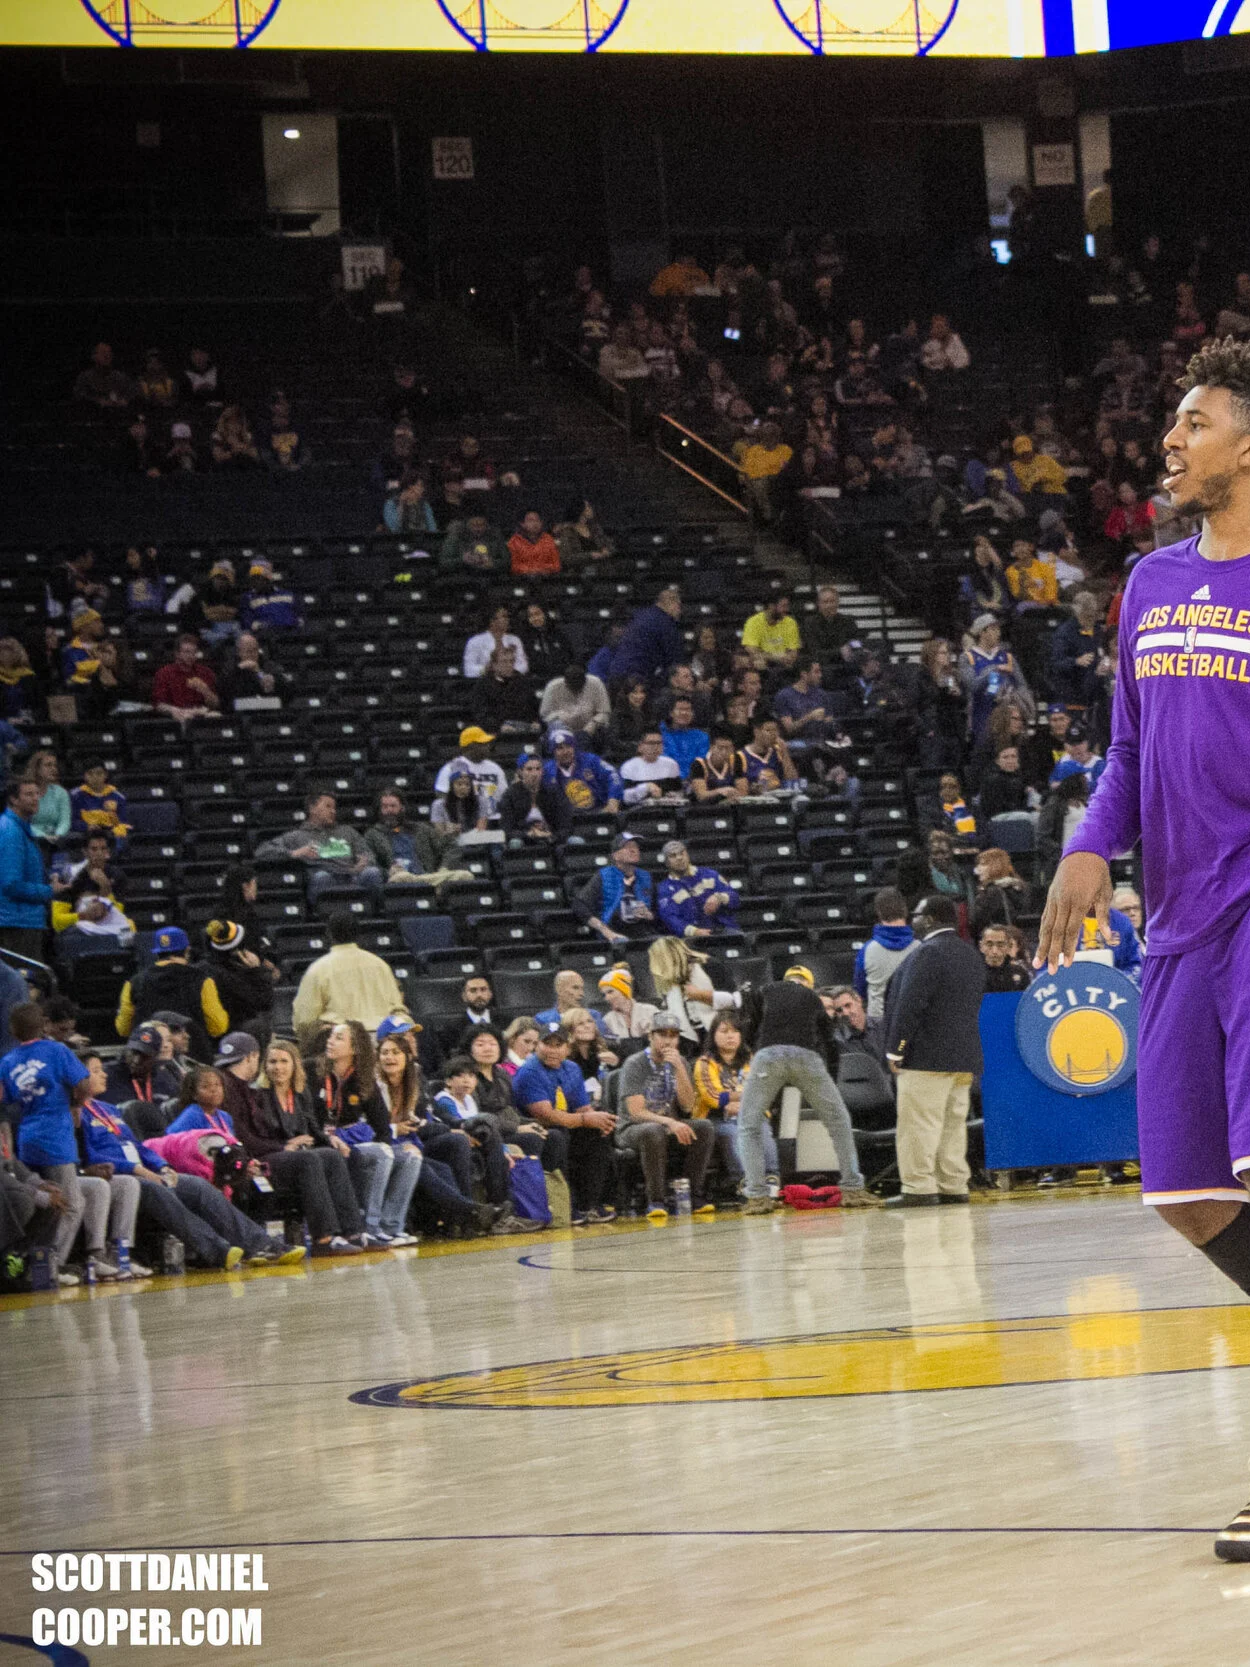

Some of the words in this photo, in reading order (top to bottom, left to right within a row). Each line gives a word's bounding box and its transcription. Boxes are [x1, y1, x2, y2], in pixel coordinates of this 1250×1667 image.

[435, 154, 471, 173] 120
[1137, 605, 1172, 632] LOS
[1135, 652, 1250, 683] BASKETBALL
[1042, 986, 1127, 1018] CITY
